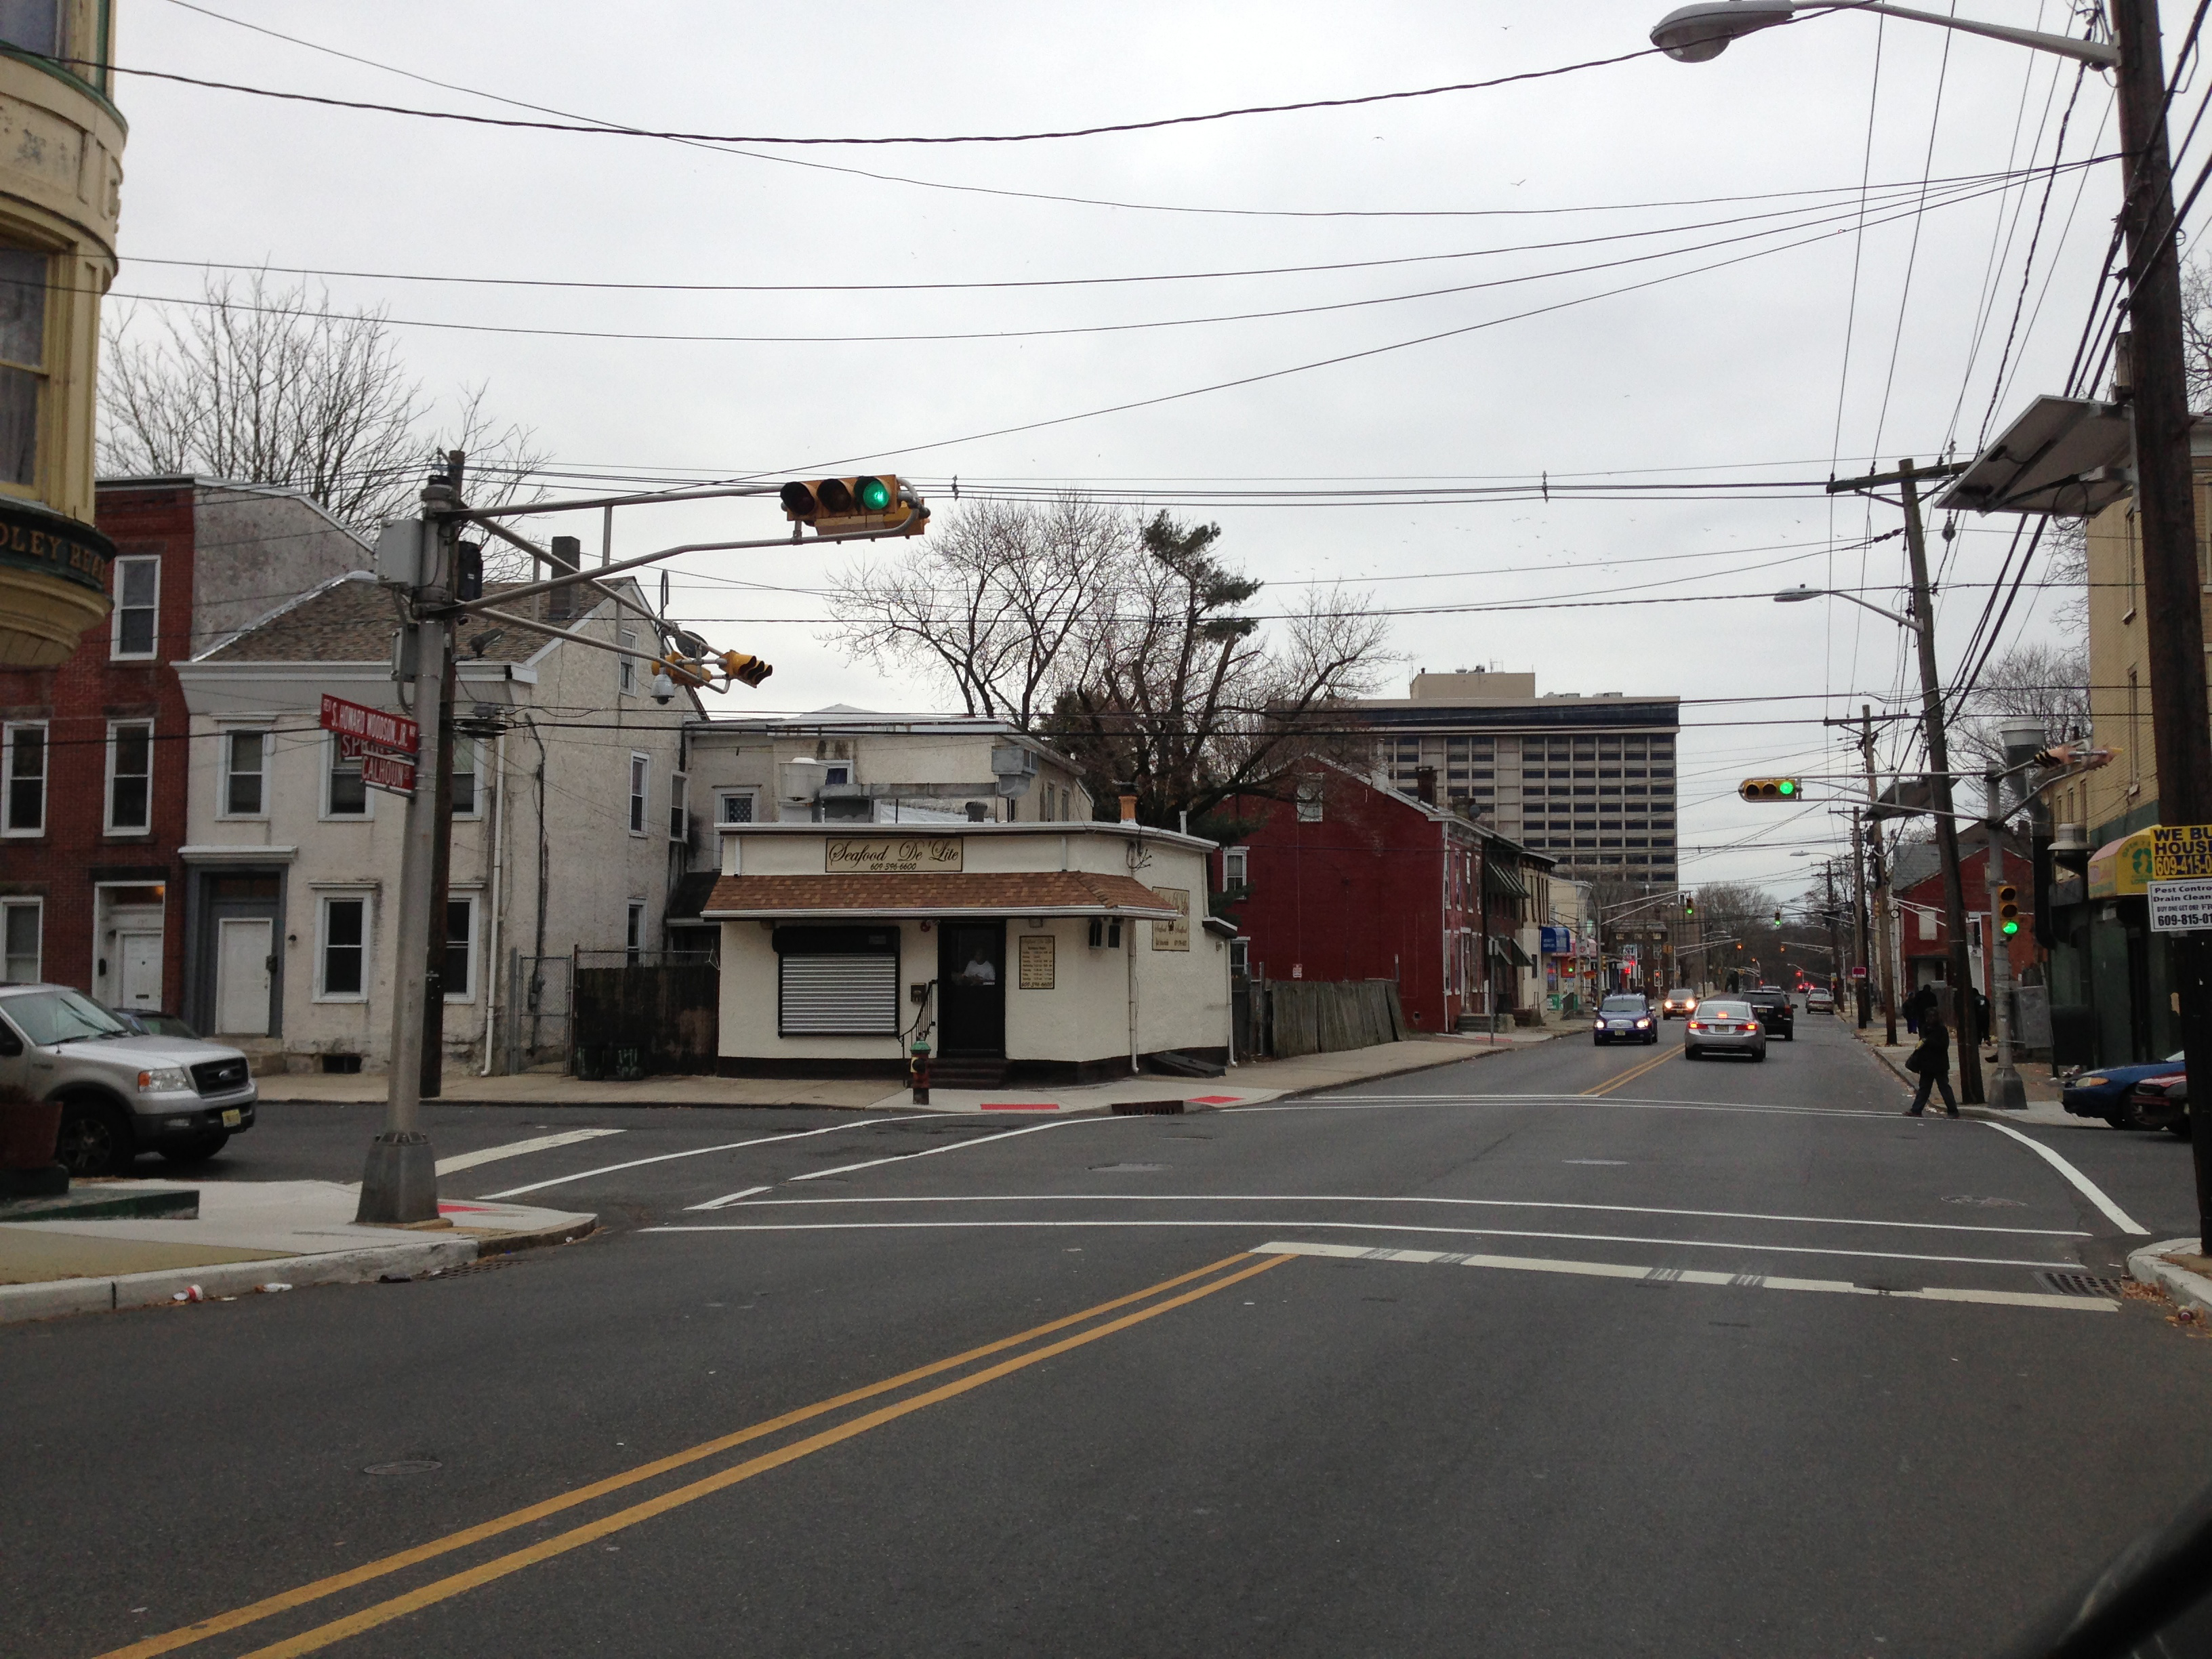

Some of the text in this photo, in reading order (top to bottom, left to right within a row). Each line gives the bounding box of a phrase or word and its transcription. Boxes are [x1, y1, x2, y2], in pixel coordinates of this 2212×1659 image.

[362, 756, 404, 787] CALHOUN
[2153, 828, 2184, 841] WE
[829, 840, 890, 868] Seafood
[869, 862, 917, 871] 609-396-6600
[2155, 855, 2212, 876] 609-415-0
